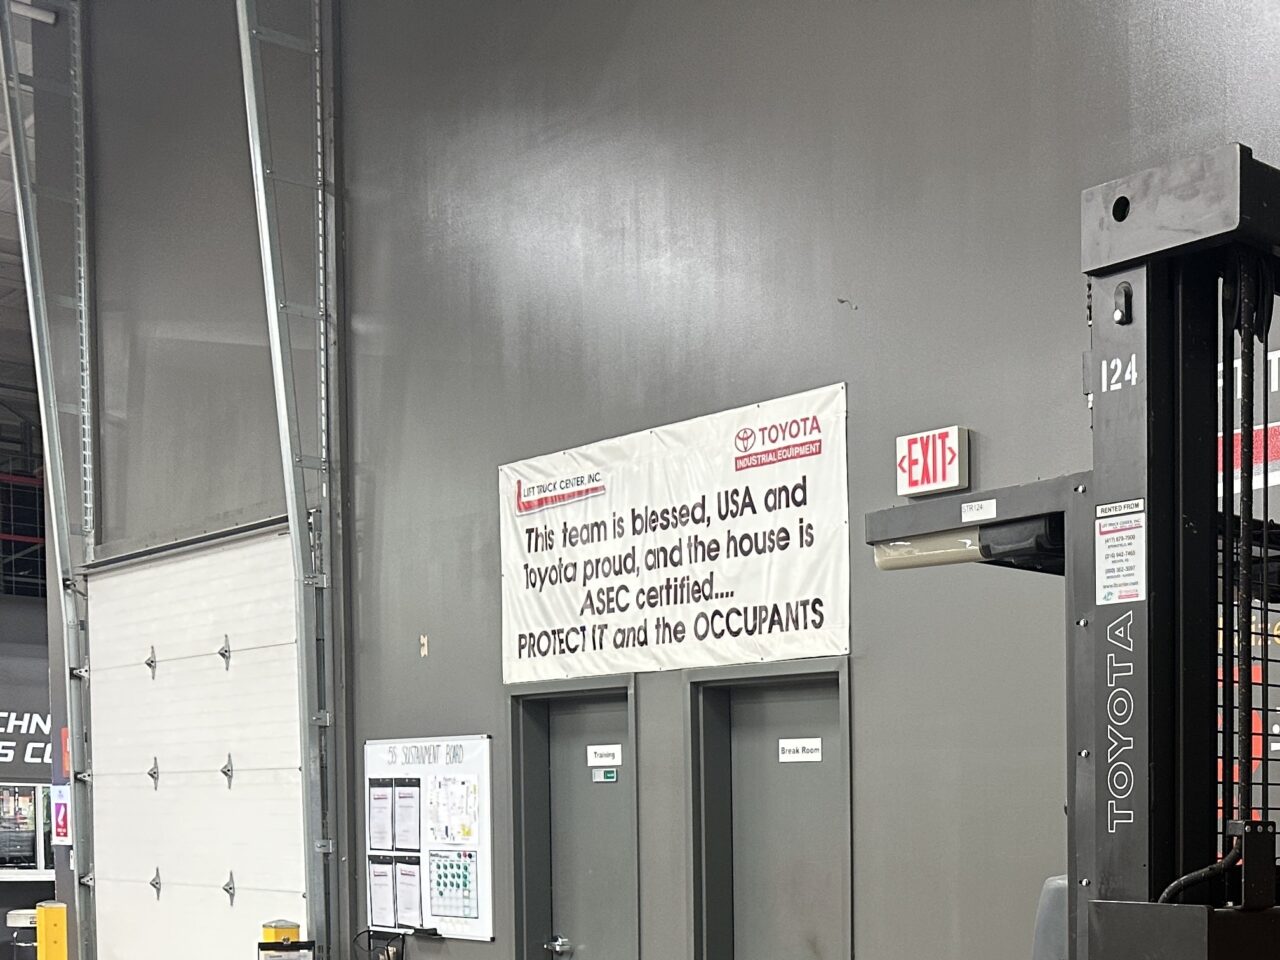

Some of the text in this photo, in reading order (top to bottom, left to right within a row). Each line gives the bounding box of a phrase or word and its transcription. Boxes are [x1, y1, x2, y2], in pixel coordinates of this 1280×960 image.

[1101, 353, 1138, 392] 124
[758, 415, 821, 446] TOYOTA
[736, 442, 821, 469] INDUSTRIAL EQUIPMENT
[907, 431, 949, 488] EXIT
[536, 481, 558, 495] TRUCK
[587, 471, 602, 484] INC.
[526, 475, 807, 553] This team is blessed, USA and
[1100, 502, 1140, 514] RENTED FROM
[524, 518, 814, 592] Toyota proud, and the house is
[579, 584, 630, 616] ASEC
[518, 597, 825, 659] PROTECT IT and the OCCUPANTS
[1107, 610, 1134, 833] TOYOTA
[593, 751, 616, 760] Training
[780, 746, 820, 755] Break Room
